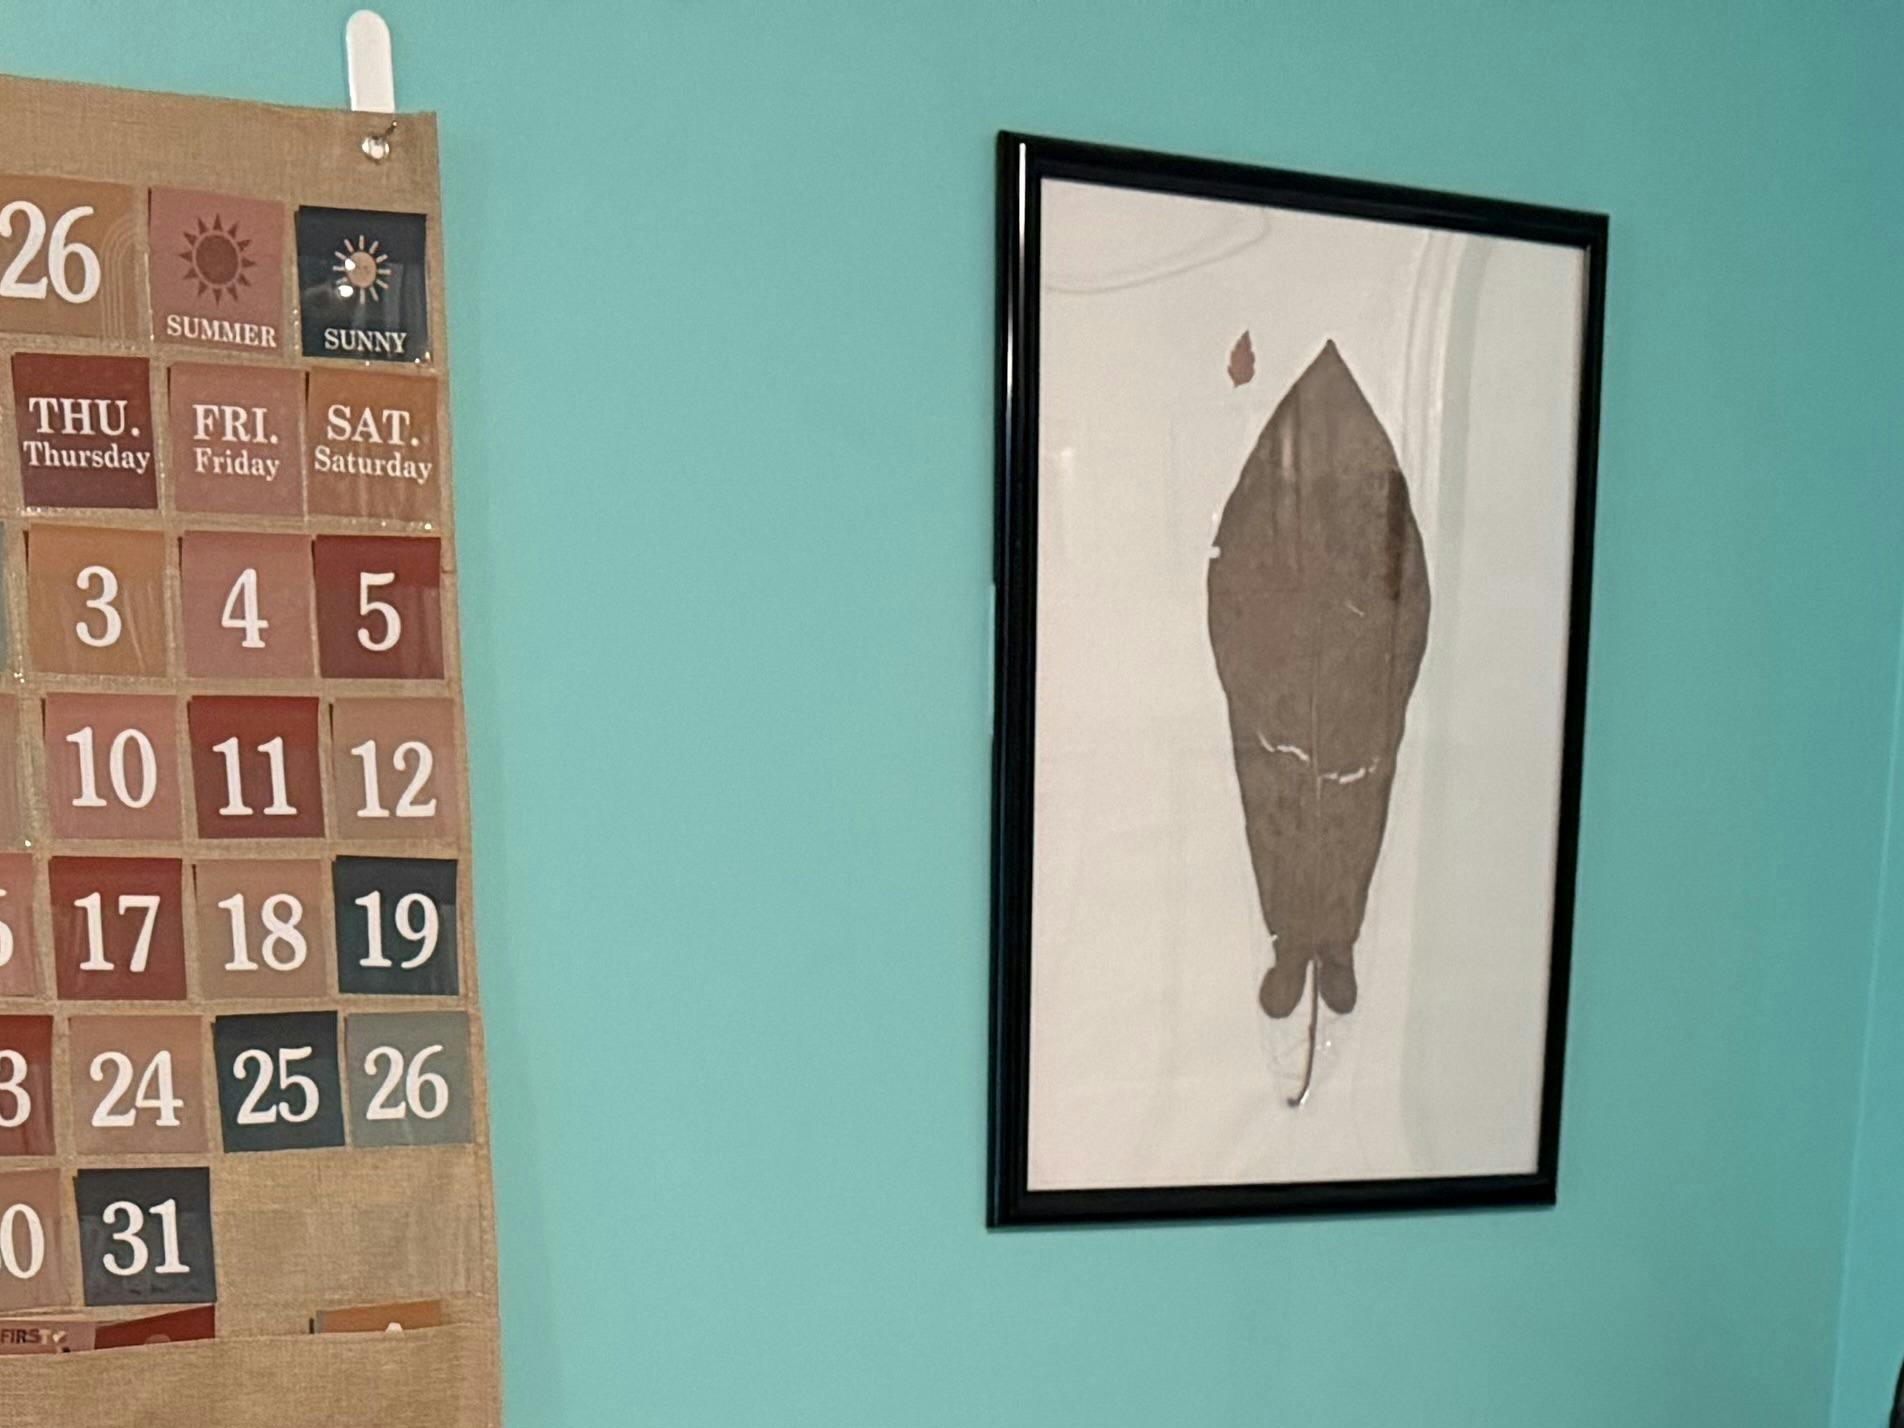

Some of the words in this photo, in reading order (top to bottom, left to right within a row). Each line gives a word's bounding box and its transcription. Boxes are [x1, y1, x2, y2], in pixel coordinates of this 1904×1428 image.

[167, 314, 277, 348] SUMMER
[324, 328, 407, 354] SUNNY
[28, 397, 140, 437] THU.
[192, 404, 278, 444] FRI.
[326, 404, 420, 447] SAT.
[22, 440, 151, 475] Thursday
[194, 447, 280, 482] Friday
[314, 445, 433, 485] Saturday
[75, 565, 122, 647] 3
[221, 568, 269, 648] 4
[357, 571, 402, 651] 5
[65, 726, 157, 809] 10
[212, 736, 297, 816] 11
[350, 739, 437, 818] 12
[73, 891, 161, 973] 17
[217, 893, 307, 971] 18
[354, 890, 439, 969] 19
[89, 1050, 184, 1128] 24
[232, 1046, 320, 1125] 25
[364, 1044, 449, 1120] 26
[102, 1198, 190, 1276] 31
[0, 1326, 53, 1346] FIRST
